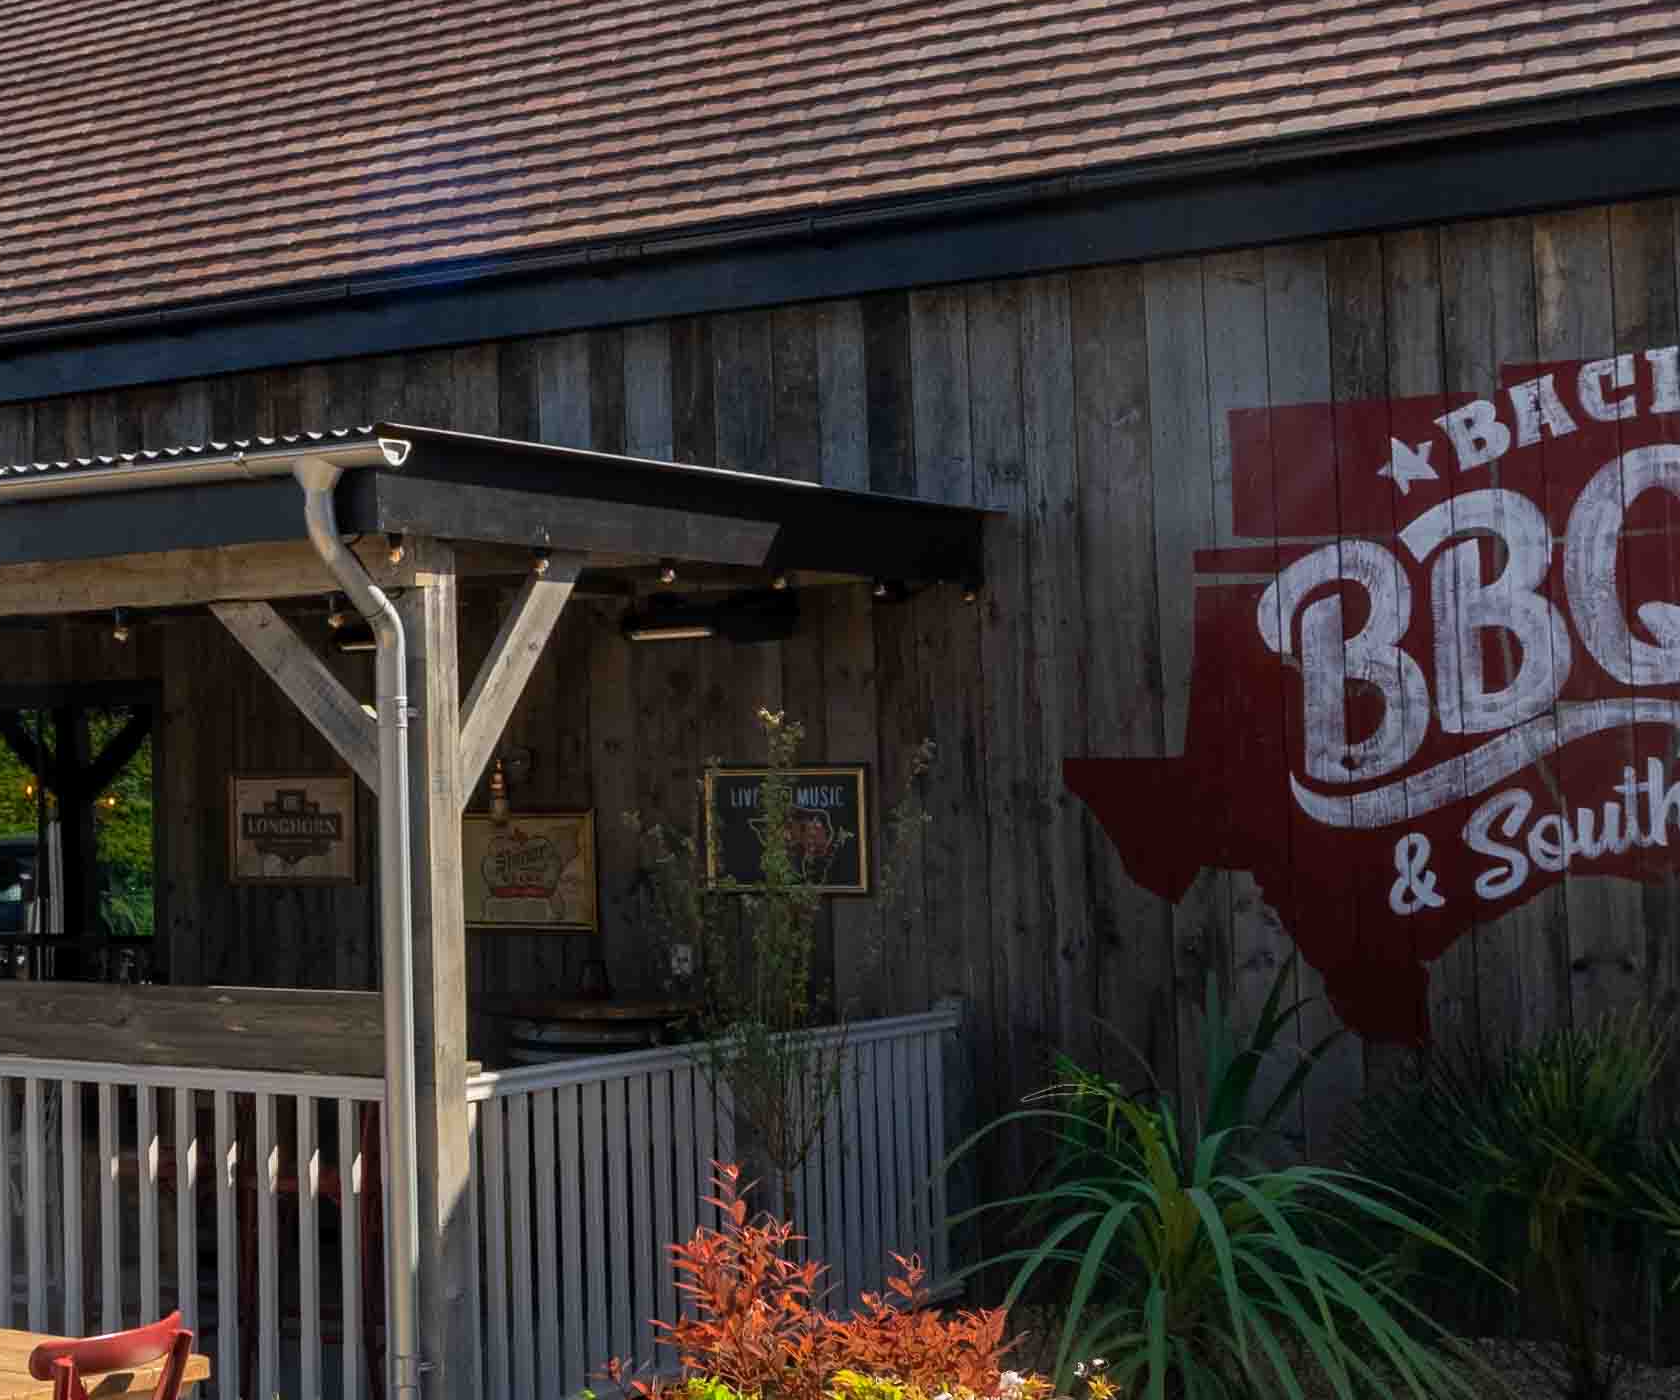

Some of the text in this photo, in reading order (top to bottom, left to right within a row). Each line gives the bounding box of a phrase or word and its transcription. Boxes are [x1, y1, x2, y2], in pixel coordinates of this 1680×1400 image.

[796, 784, 845, 808] MUSIC
[247, 815, 337, 833] LONGHORN
[1388, 832, 1445, 915] &
